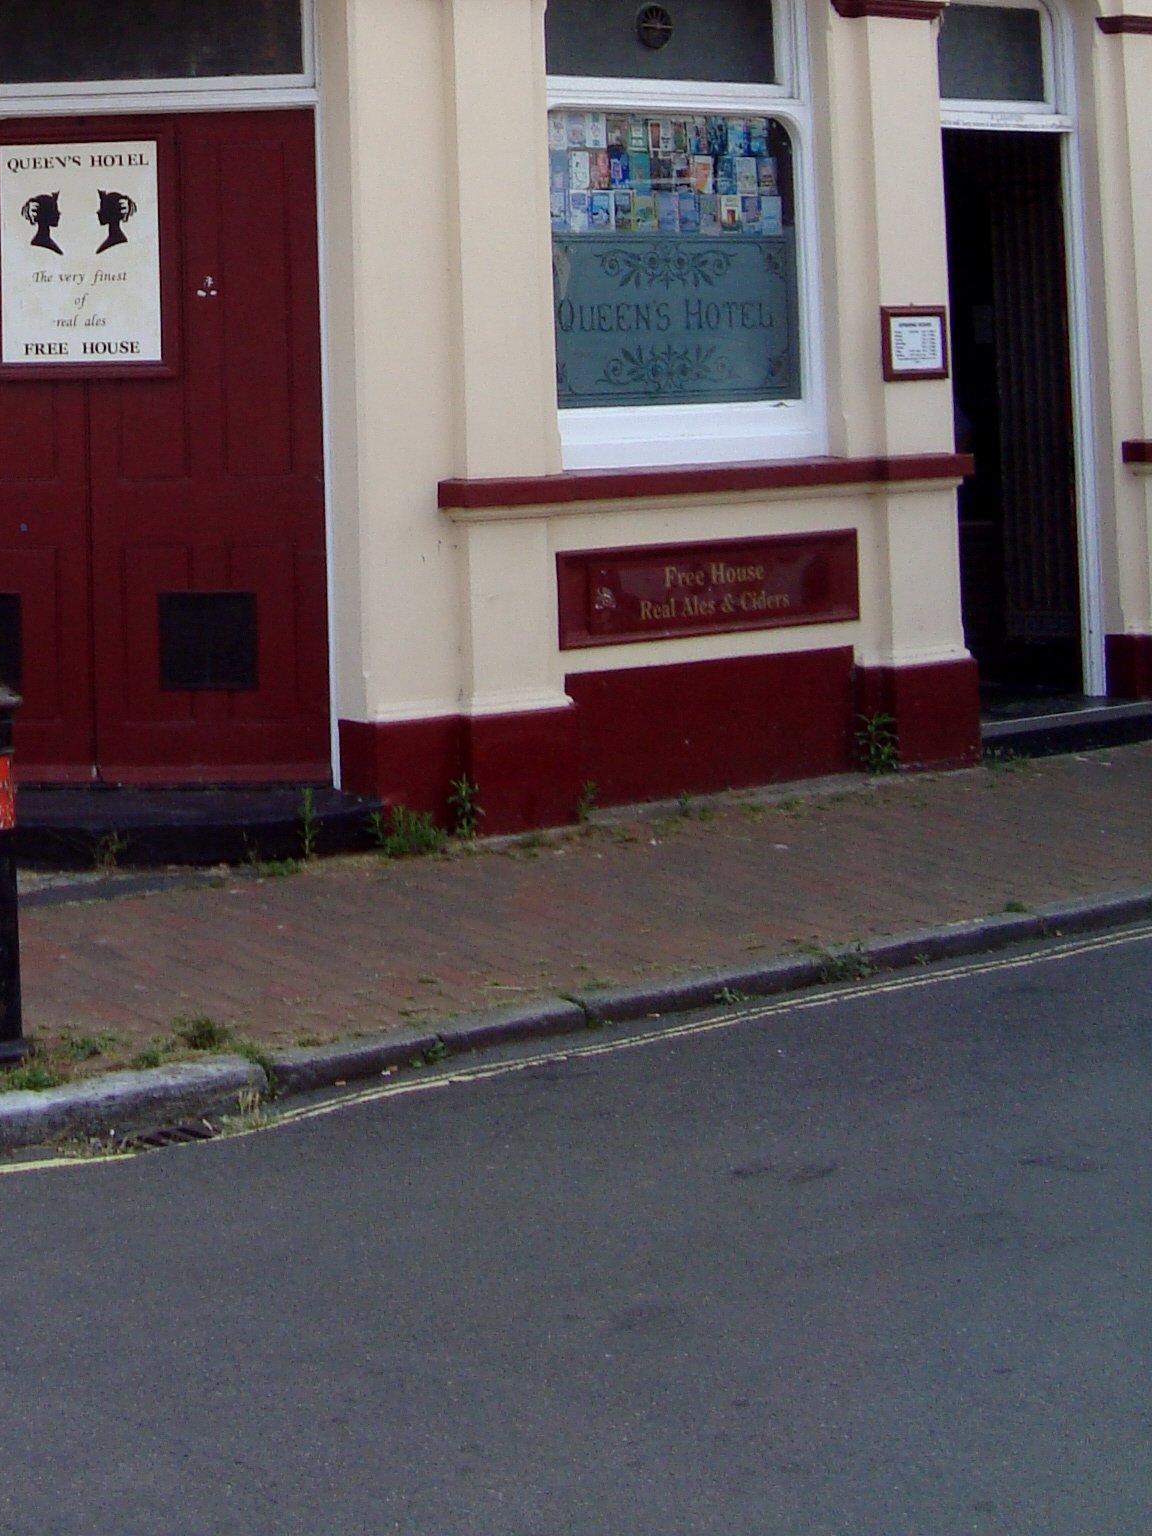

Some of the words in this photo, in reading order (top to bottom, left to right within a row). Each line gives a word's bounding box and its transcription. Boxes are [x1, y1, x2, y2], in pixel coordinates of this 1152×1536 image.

[6, 154, 82, 174] QUEEN'S
[89, 153, 149, 168] HOTEL
[32, 270, 54, 284] The
[57, 272, 86, 287] very
[90, 269, 128, 287] finest
[74, 292, 90, 310] of
[84, 314, 107, 328] ales
[684, 297, 776, 331] HOTEL
[24, 342, 70, 356] FREE
[82, 340, 141, 355] HOUSE
[663, 565, 705, 589] Free
[710, 561, 765, 584] House
[640, 598, 676, 621] Real
[682, 595, 716, 618] Ales
[720, 594, 735, 613] &
[738, 589, 791, 610] Ciders
